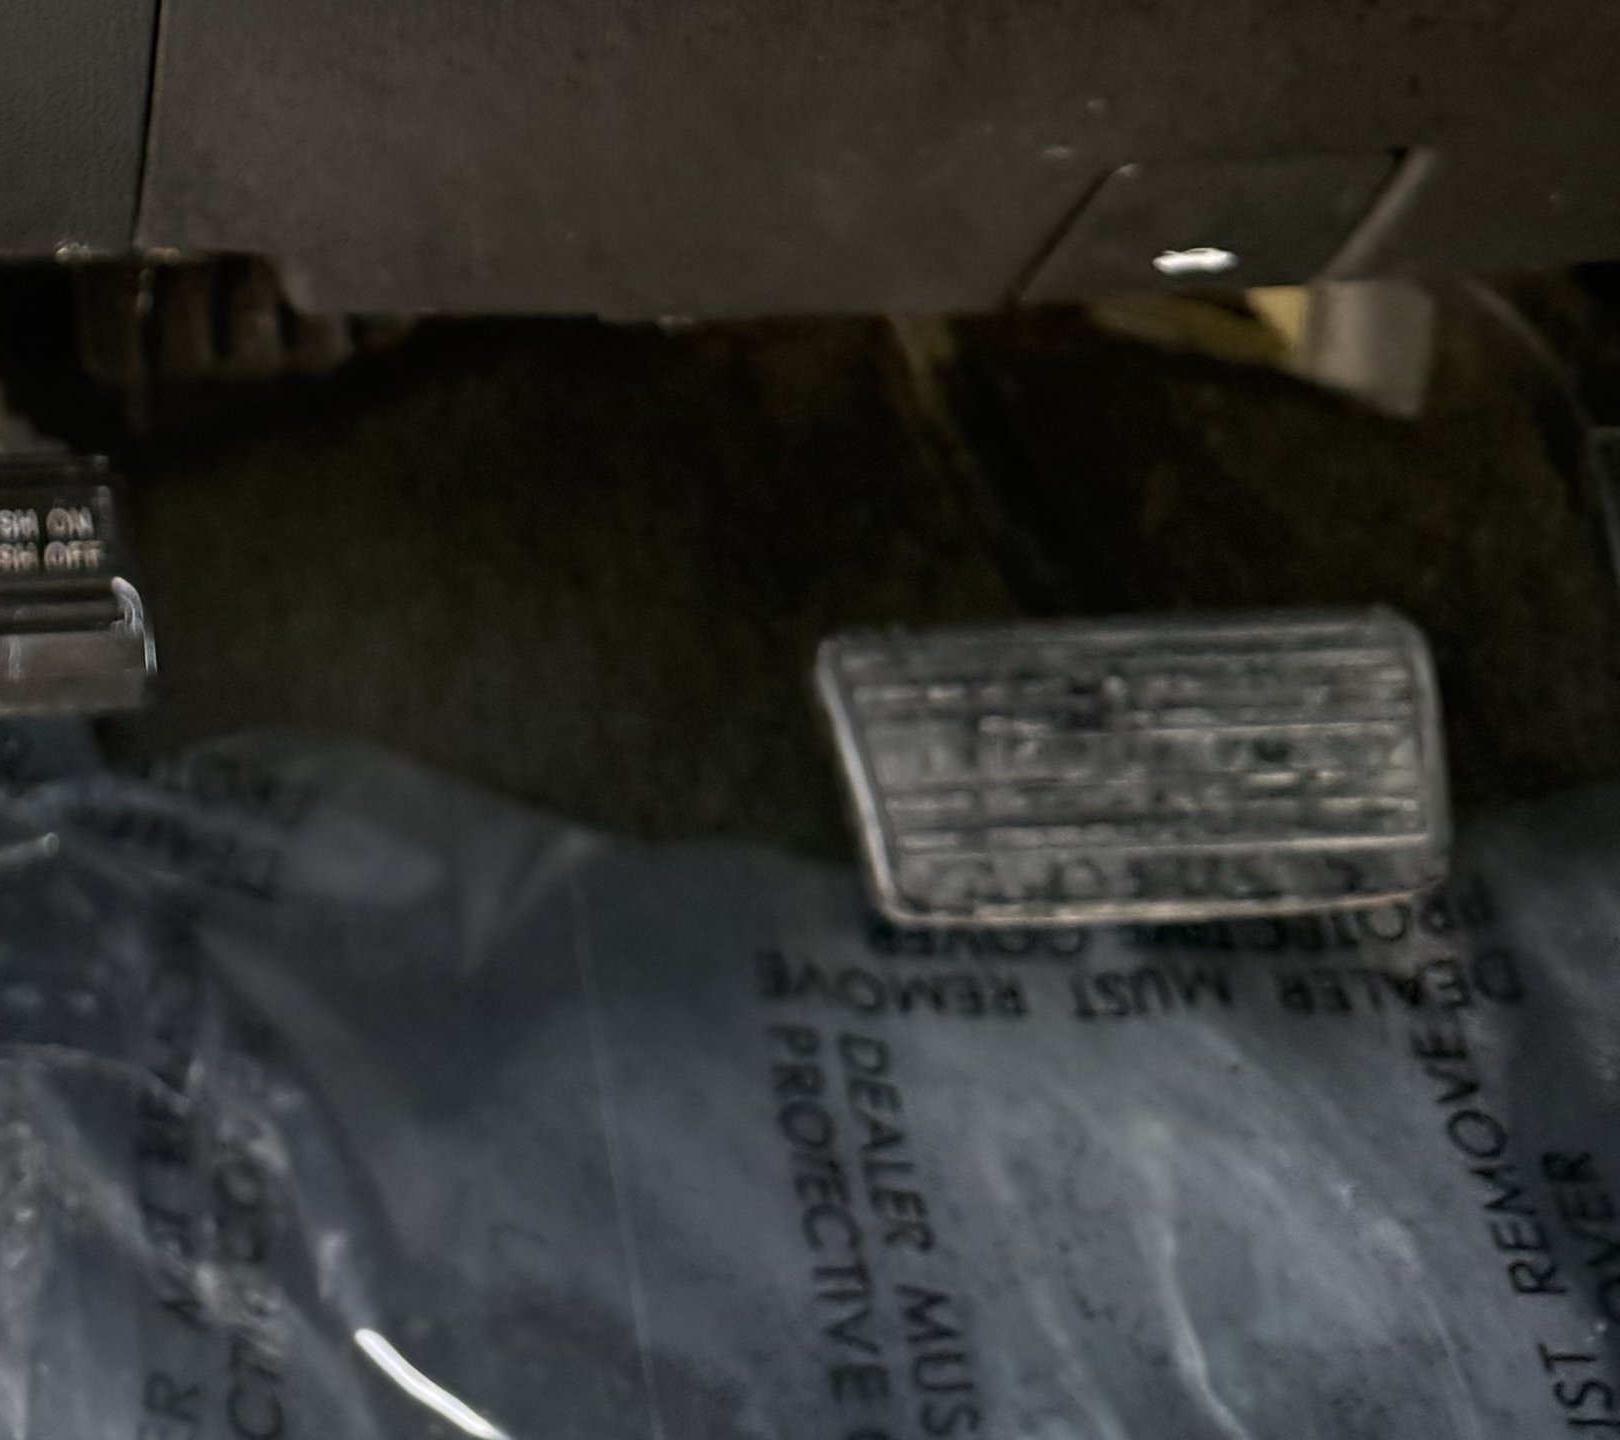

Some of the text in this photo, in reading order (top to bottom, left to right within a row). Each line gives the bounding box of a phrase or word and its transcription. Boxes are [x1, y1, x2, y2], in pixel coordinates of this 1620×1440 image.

[47, 507, 94, 540] ON
[754, 946, 1528, 1020] DEALER MUST REMOVE
[770, 1023, 892, 1404] PROTECTIVE
[837, 1030, 936, 1254] DEALER
[1410, 1028, 1568, 1297] REMOVE
